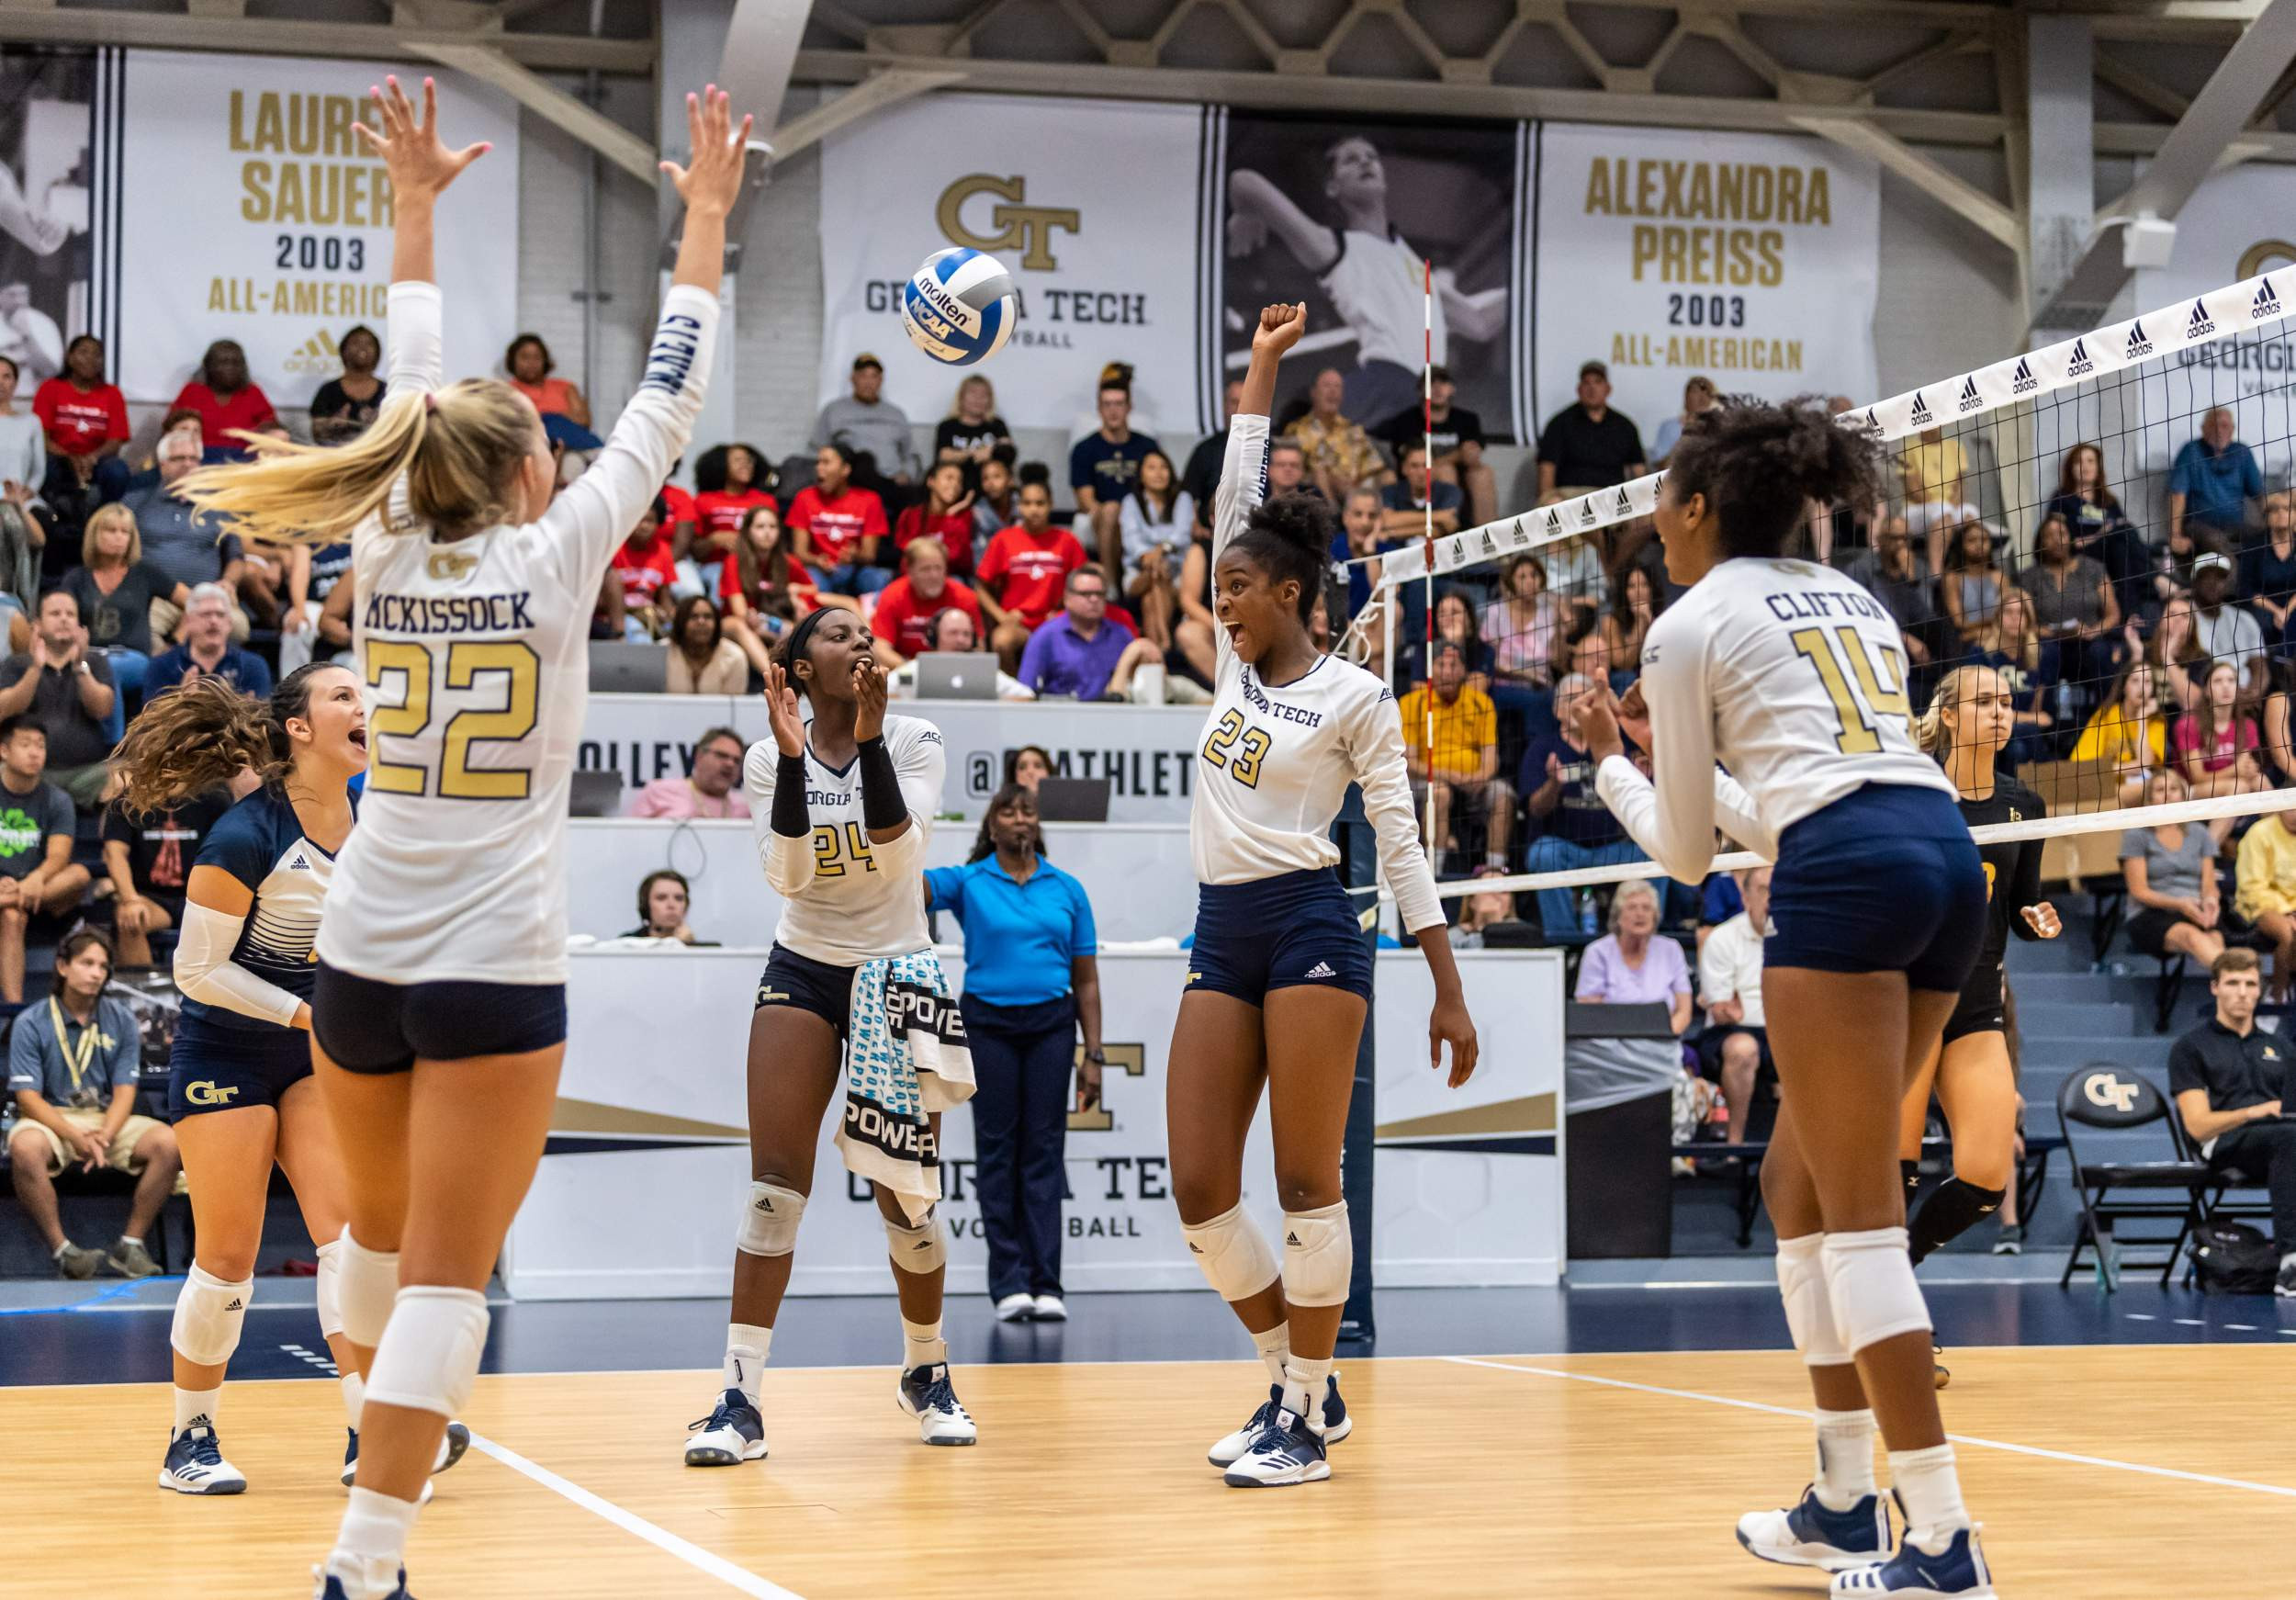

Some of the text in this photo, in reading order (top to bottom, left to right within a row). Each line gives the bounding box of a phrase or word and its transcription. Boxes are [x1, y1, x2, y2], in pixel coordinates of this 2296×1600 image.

[1583, 158, 1831, 226] ALEXANDRA
[935, 174, 1082, 271] GT
[276, 234, 366, 272] 2003
[1630, 224, 1784, 287] PREISS
[208, 277, 388, 320] ALL-AMERIC
[919, 277, 968, 326] molten
[1044, 289, 1148, 324] TECH
[1667, 293, 1746, 328] 2003
[2252, 300, 2281, 320] adidas
[908, 295, 950, 342] NCAA
[2187, 321, 2215, 340] adidas
[1611, 332, 1803, 372] ALL-AMERICAN
[2067, 360, 2094, 377] adidas
[2126, 342, 2154, 360] adidas
[2012, 377, 2038, 395] adidas
[1911, 411, 1933, 427] adidas
[1959, 396, 1984, 412] adidas
[1764, 591, 1886, 622] CLIFTON
[364, 637, 541, 799] 22
[1273, 703, 1322, 727] TECH
[1201, 706, 1272, 791] 23
[805, 791, 851, 806] ORGIA
[186, 1080, 239, 1105] GT
[2084, 1073, 2139, 1112] GT
